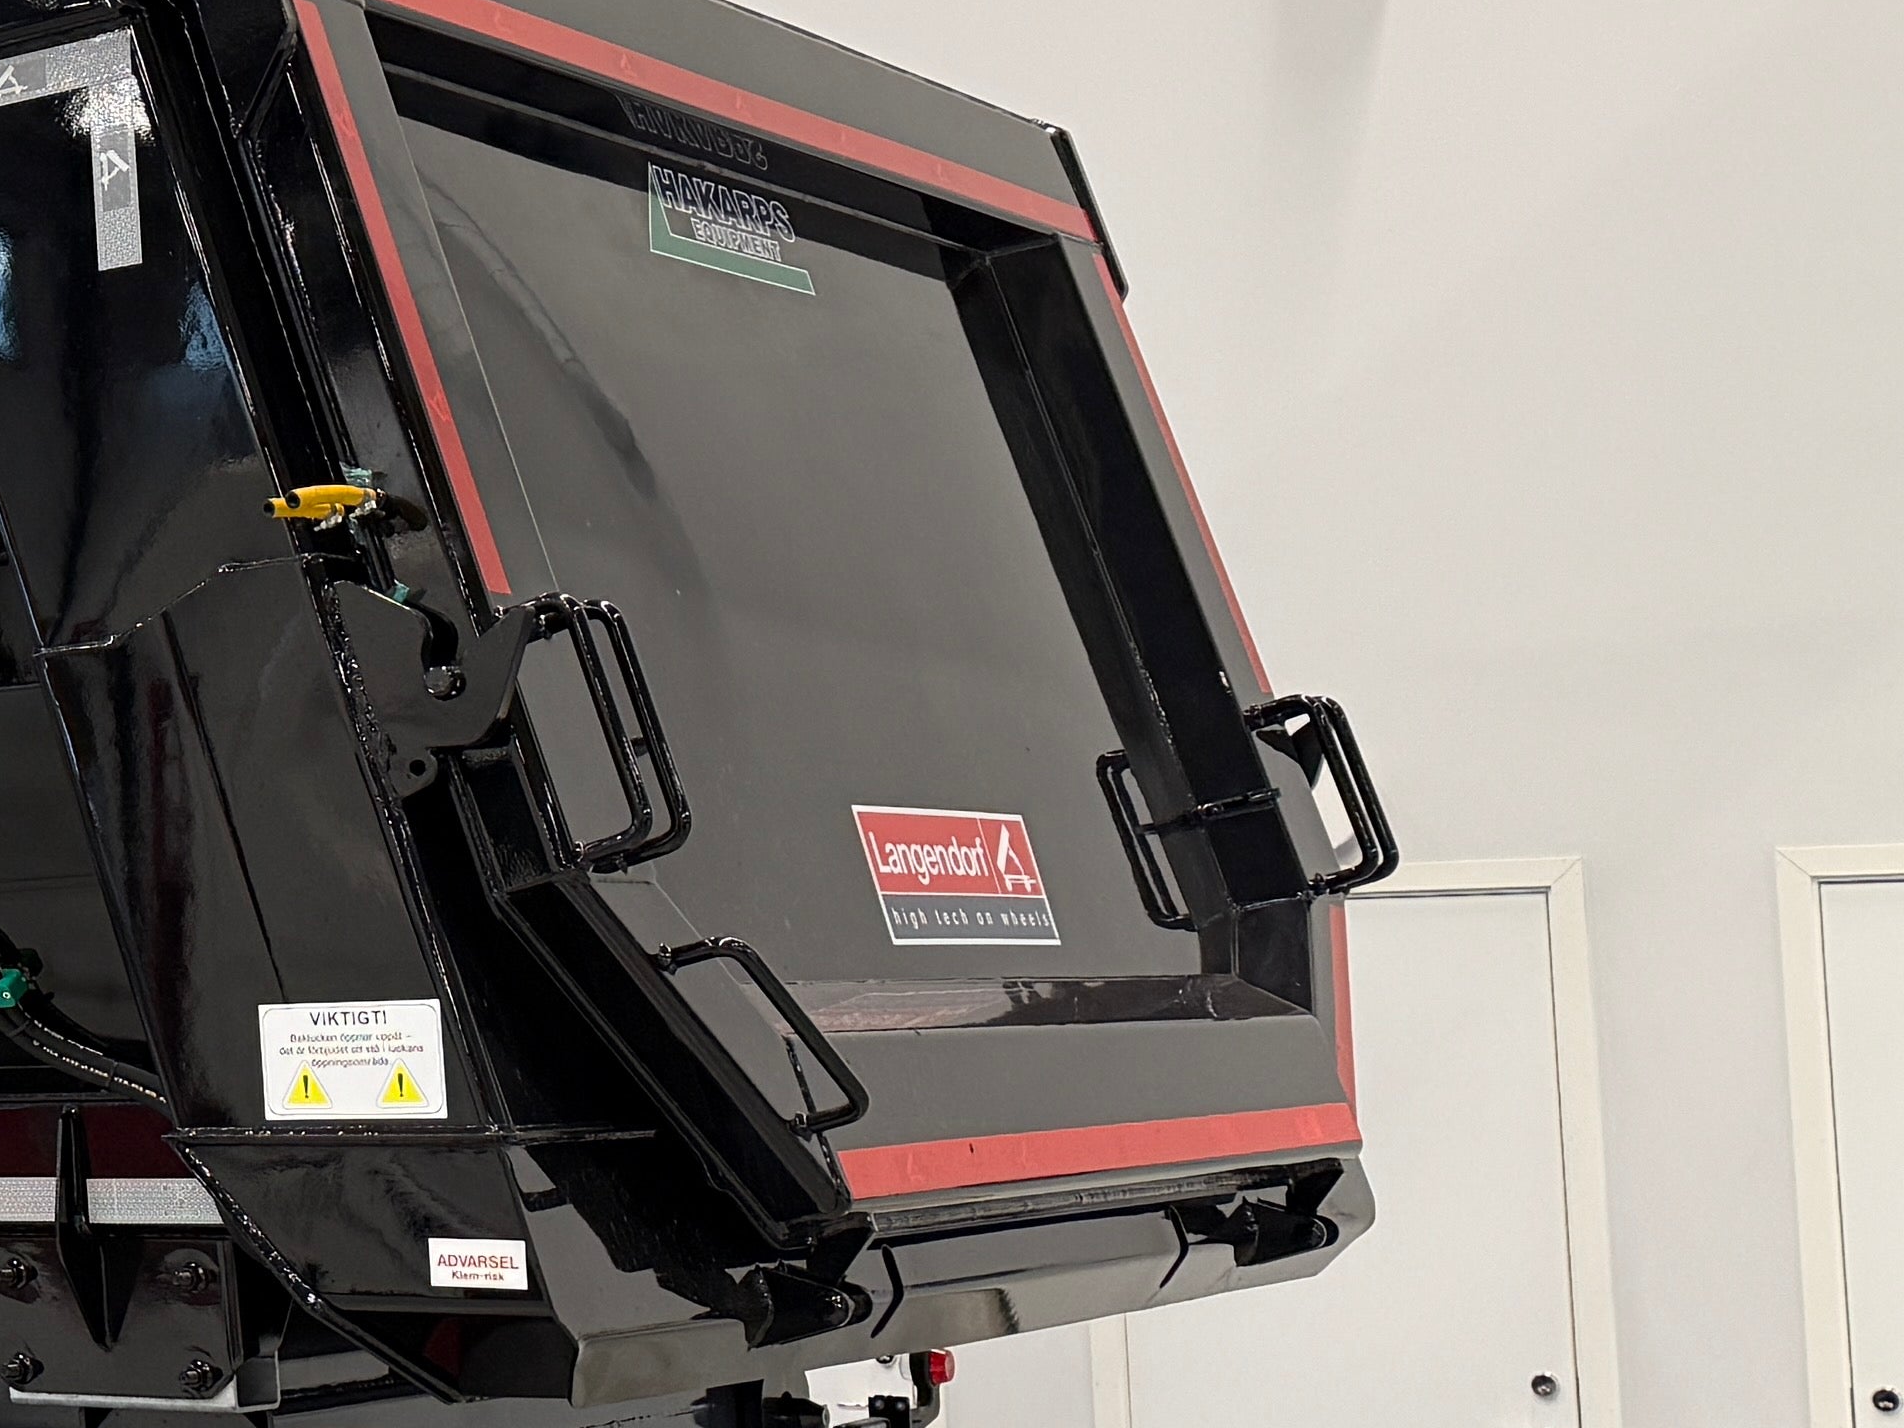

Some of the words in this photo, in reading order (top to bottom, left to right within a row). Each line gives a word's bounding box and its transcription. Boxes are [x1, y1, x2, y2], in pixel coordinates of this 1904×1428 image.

[651, 164, 796, 243] HAKARPS
[690, 217, 782, 262] EQUIPMENT
[868, 831, 990, 886] Langendorf
[891, 907, 928, 931] high
[935, 907, 969, 926] tech
[976, 910, 994, 925] on
[1000, 909, 1051, 927] wheels
[437, 1254, 520, 1270] ADVARSEL
